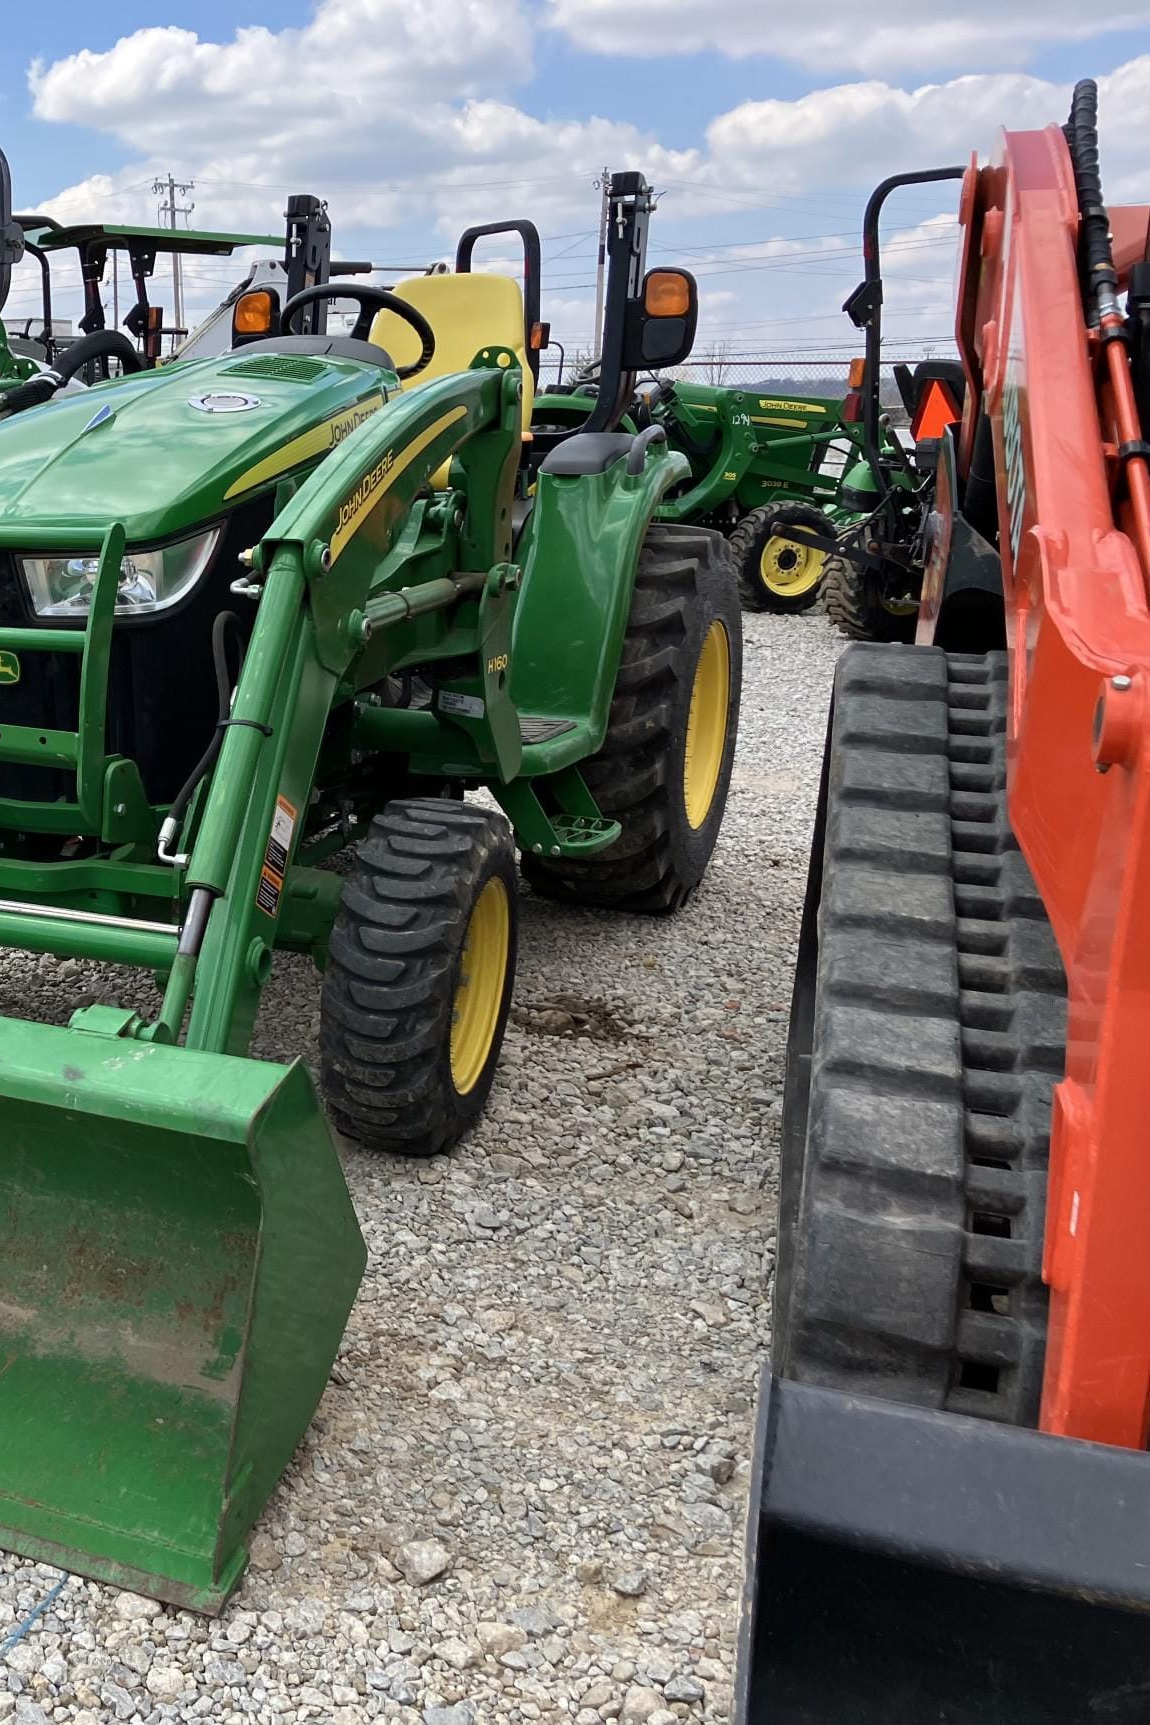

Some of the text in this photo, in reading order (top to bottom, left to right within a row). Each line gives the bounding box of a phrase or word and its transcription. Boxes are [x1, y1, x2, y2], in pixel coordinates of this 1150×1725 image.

[329, 417, 354, 446] JOHN
[336, 449, 395, 532] JOHN DEERE
[488, 654, 508, 674] H160
